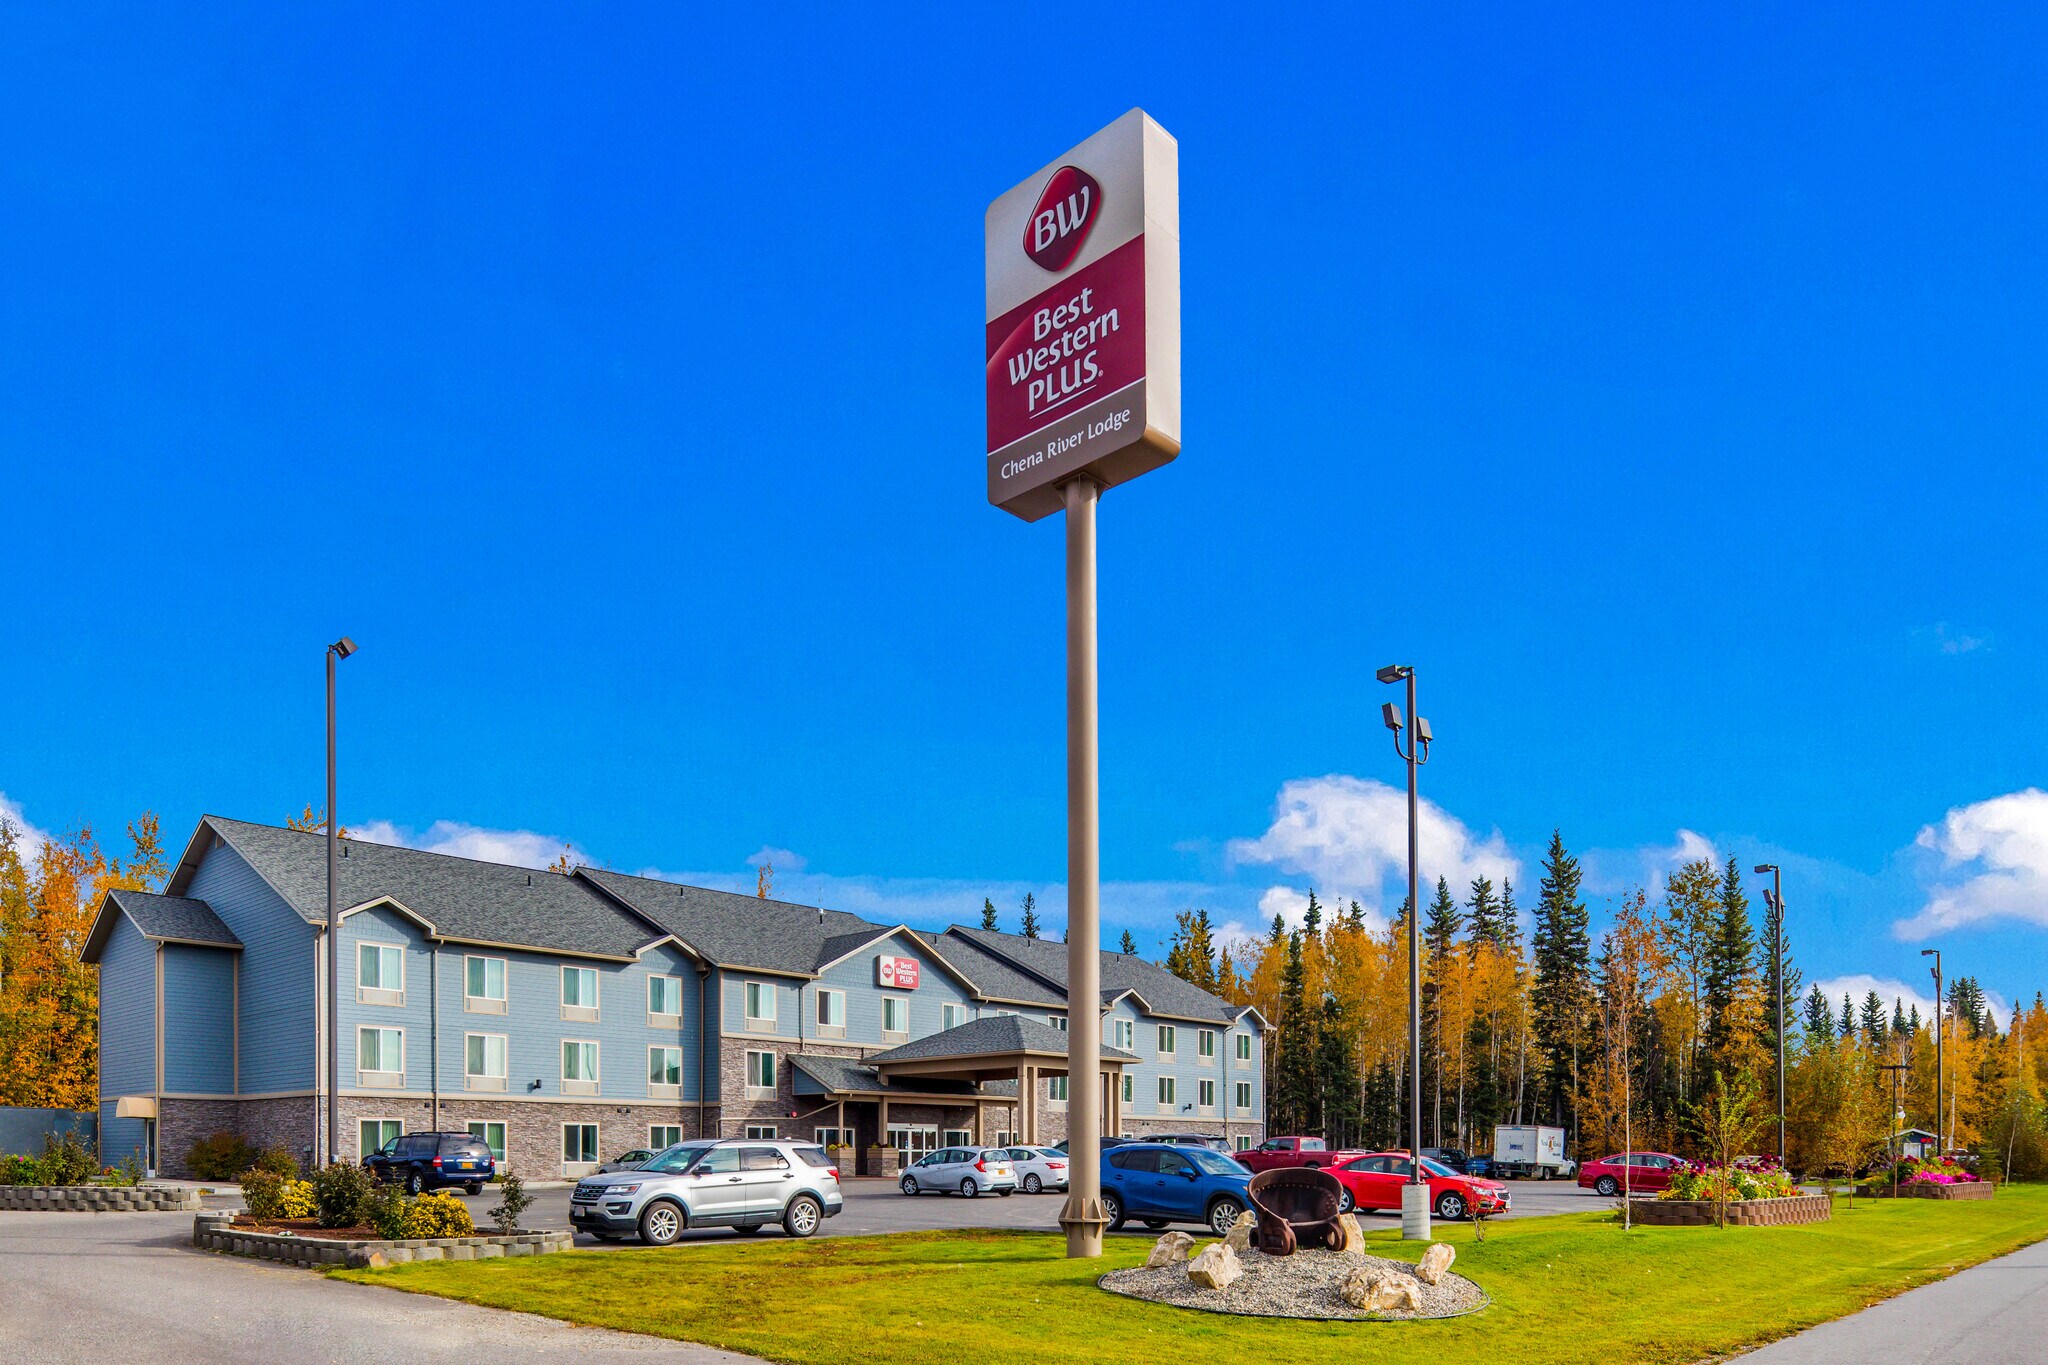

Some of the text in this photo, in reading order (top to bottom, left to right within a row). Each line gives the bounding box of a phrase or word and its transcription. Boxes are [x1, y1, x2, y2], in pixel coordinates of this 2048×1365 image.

[1034, 185, 1090, 253] BW
[1033, 287, 1093, 342] Best
[1008, 307, 1119, 386] Western
[1001, 406, 1131, 480] Chena River Lodge
[896, 968, 917, 976] Western
[900, 961, 912, 969] Best
